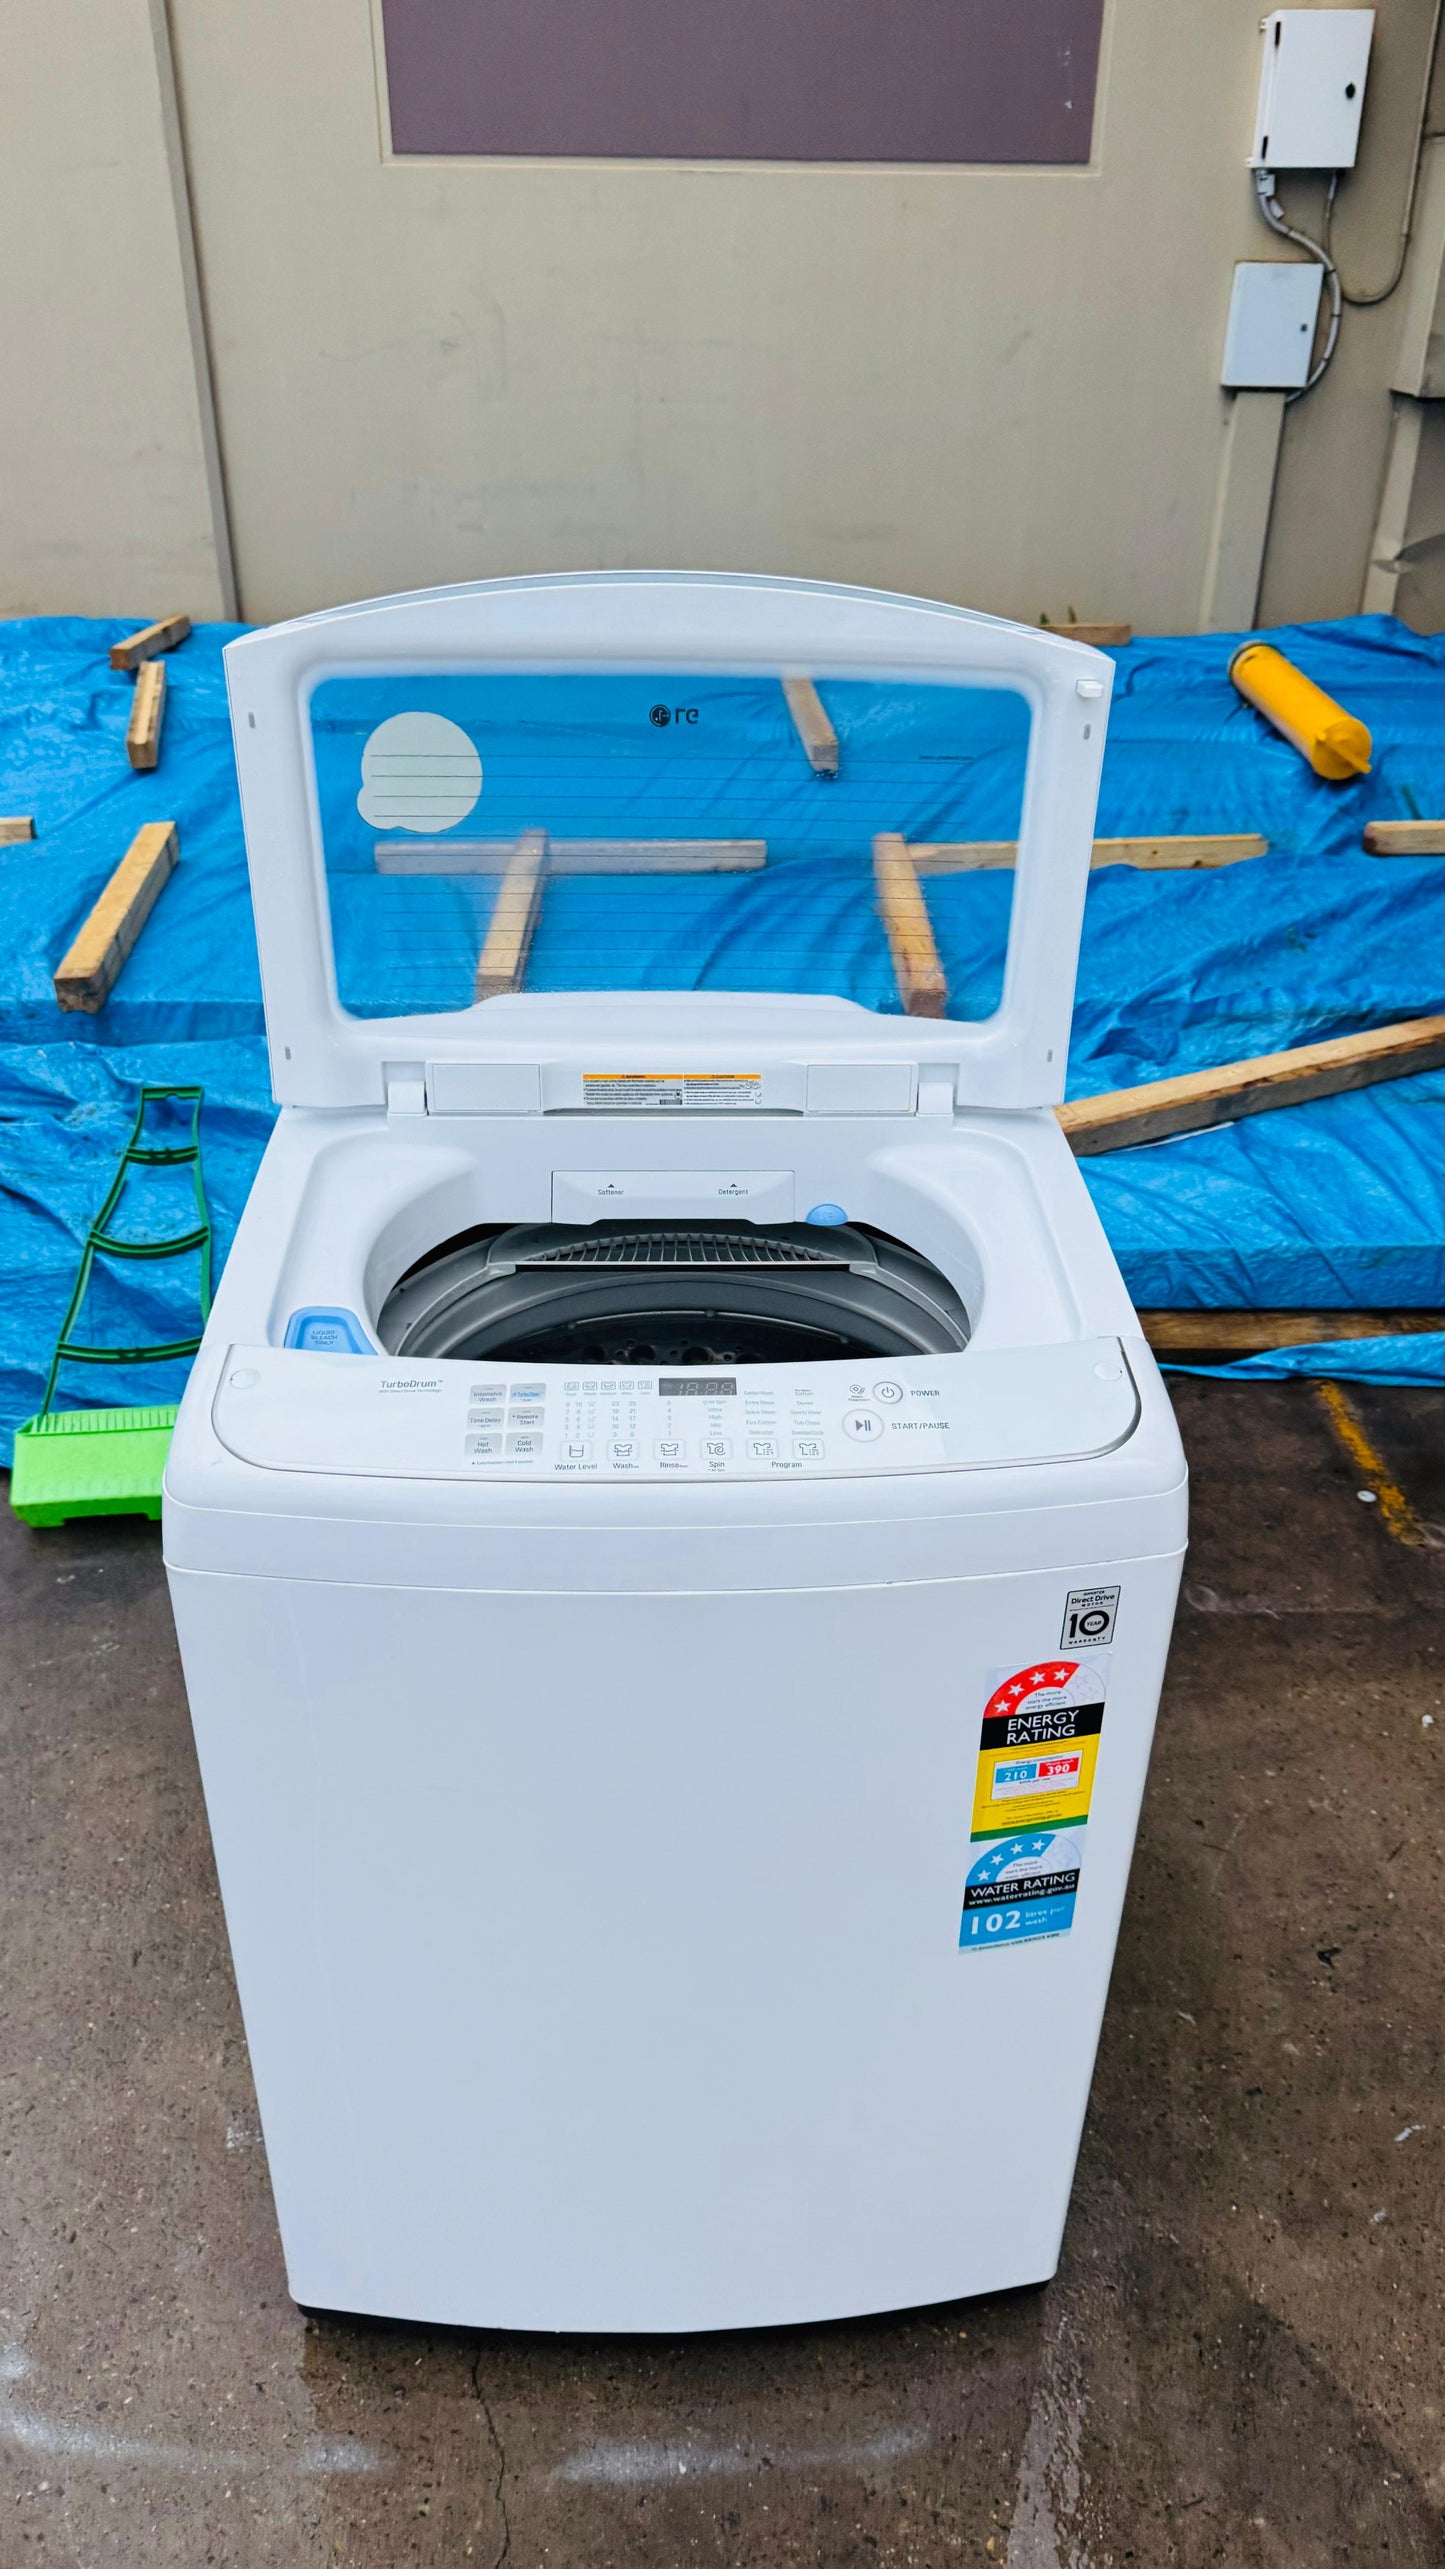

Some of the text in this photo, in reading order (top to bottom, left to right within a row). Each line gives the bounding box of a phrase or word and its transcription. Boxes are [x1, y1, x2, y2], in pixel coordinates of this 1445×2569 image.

[718, 1188, 749, 1196] Detergent
[892, 1422, 950, 1430] START/PAUSE
[771, 1461, 802, 1469] Program
[1071, 1596, 1094, 1604] Direct
[1069, 1610, 1110, 1638] 10
[1069, 1636, 1105, 1645] WARRANTY
[1008, 1710, 1079, 1731] ENERGY
[1006, 1724, 1075, 1745] RATING
[1005, 1770, 1027, 1781] 210
[1047, 1764, 1070, 1776] 390
[971, 1872, 1075, 1898] WATER RATING
[968, 1884, 1075, 1906] www.waterrating.gov.au
[1026, 1906, 1065, 1918] litres per
[971, 1910, 1021, 1934] 102
[1025, 1918, 1048, 1926] wash
